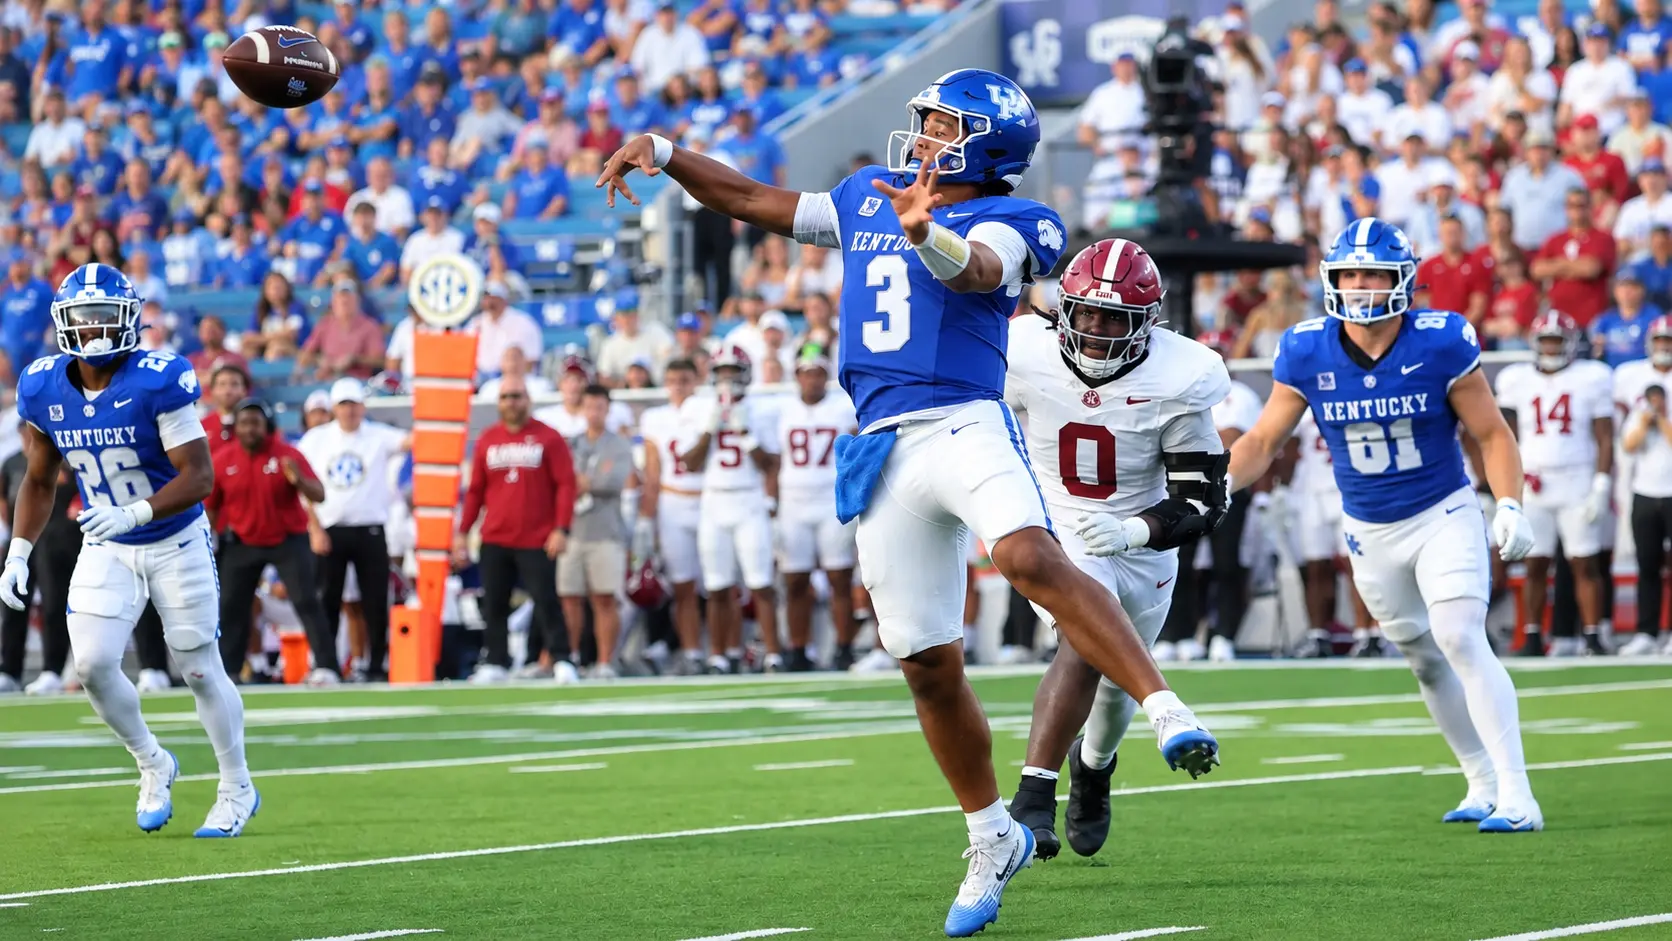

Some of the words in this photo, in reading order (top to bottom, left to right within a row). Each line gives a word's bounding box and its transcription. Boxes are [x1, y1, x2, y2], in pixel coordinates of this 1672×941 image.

[850, 231, 915, 252] KENTUC
[862, 254, 912, 354] 3
[1322, 393, 1428, 421] KENTUCKY
[1532, 394, 1571, 435] 14
[54, 425, 137, 448] KENTUCKY
[717, 429, 742, 468] 5
[788, 427, 838, 467] 87
[1344, 417, 1423, 475] 81
[65, 446, 155, 508] 26
[1058, 421, 1118, 500] 0
